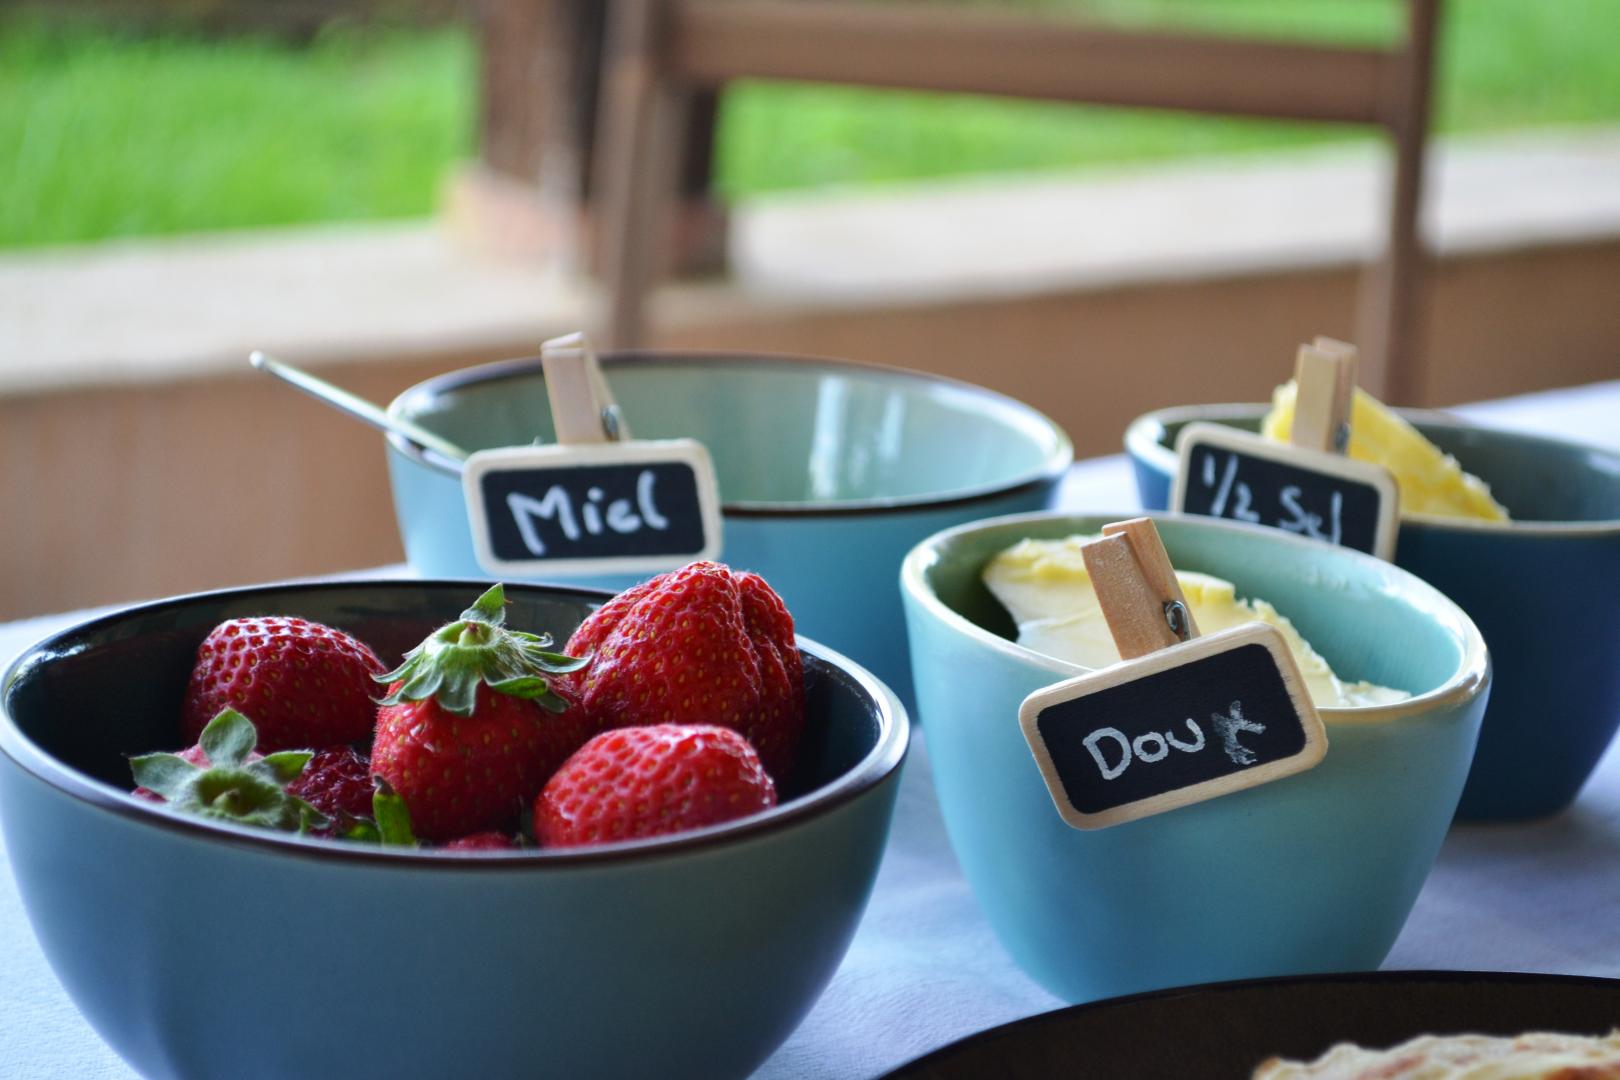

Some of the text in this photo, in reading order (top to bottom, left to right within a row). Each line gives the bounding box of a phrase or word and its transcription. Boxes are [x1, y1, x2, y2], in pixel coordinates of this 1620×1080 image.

[505, 470, 669, 556] Miel
[1202, 452, 1343, 546] 1/2 Sel
